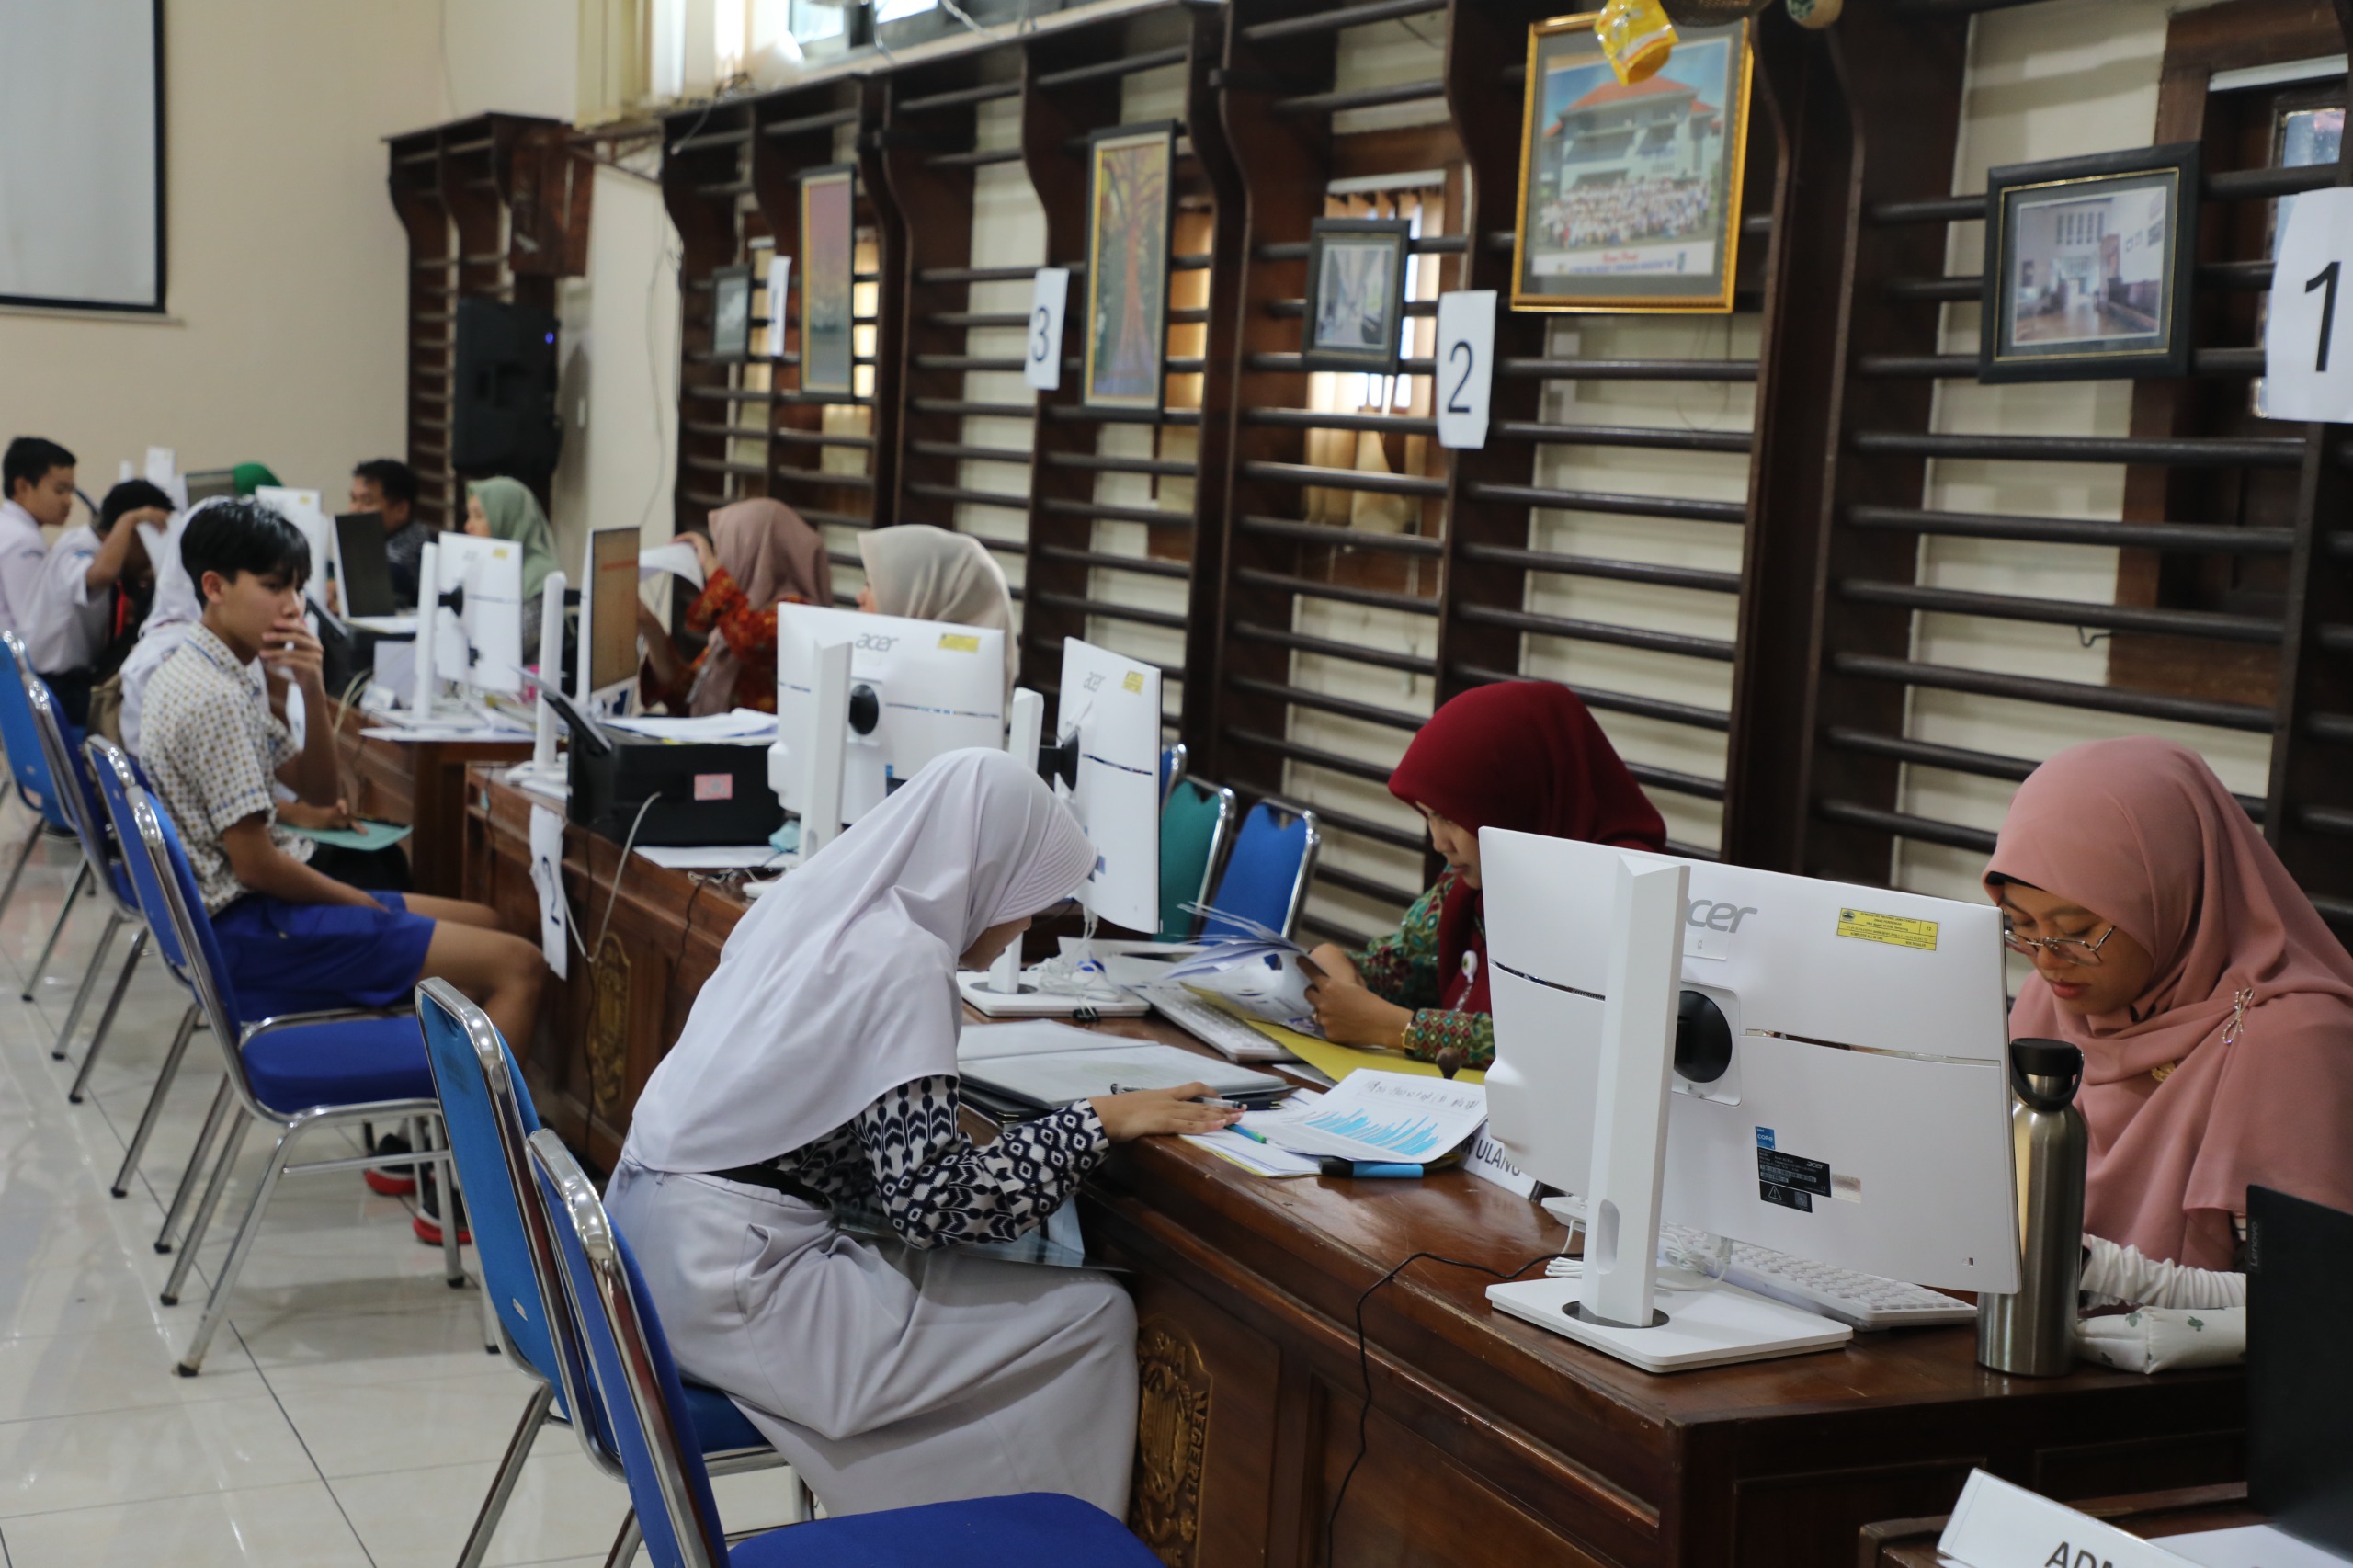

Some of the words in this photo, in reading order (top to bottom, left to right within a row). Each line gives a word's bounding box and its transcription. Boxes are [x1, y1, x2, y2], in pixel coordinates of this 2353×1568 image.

[1032, 305, 1051, 363] 3
[2304, 261, 2342, 373] 1
[1447, 340, 1473, 415] 2
[856, 632, 900, 653] acer
[1686, 899, 1758, 933] cer
[1806, 1161, 1824, 1169] acer
[2250, 1221, 2259, 1267] Lenovo
